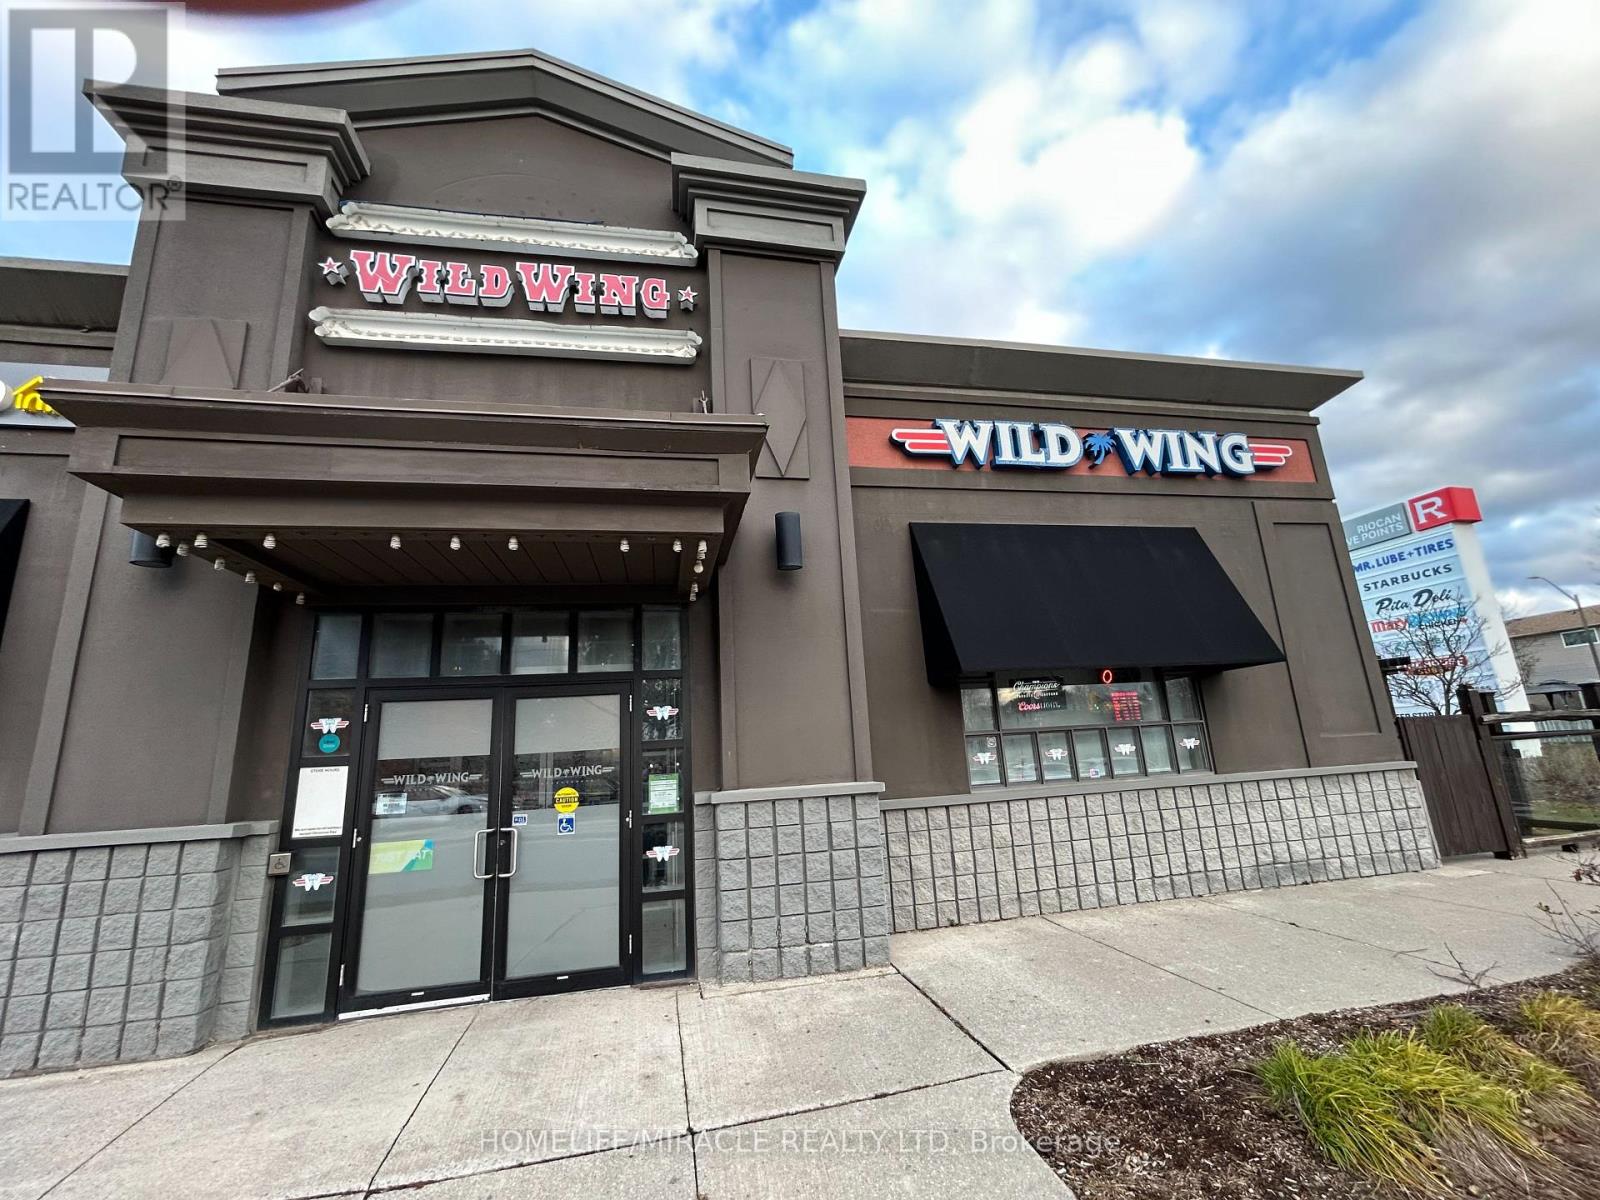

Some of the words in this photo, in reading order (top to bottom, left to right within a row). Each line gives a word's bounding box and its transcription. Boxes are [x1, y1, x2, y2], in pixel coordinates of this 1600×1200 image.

[350, 250, 514, 307] WILD
[516, 262, 670, 318] WING
[934, 418, 1084, 469] WILD
[1112, 427, 1257, 476] WING
[1357, 513, 1402, 534] RIOCAN
[1413, 496, 1448, 525] R
[1361, 521, 1404, 542] POINTS
[1363, 563, 1453, 593] STARBUCKS
[1375, 597, 1410, 615] Pita
[1413, 588, 1452, 609] Deli
[393, 773, 427, 785] WILD
[434, 771, 469, 783] WING
[531, 767, 562, 779] WILD
[569, 765, 602, 777] WING
